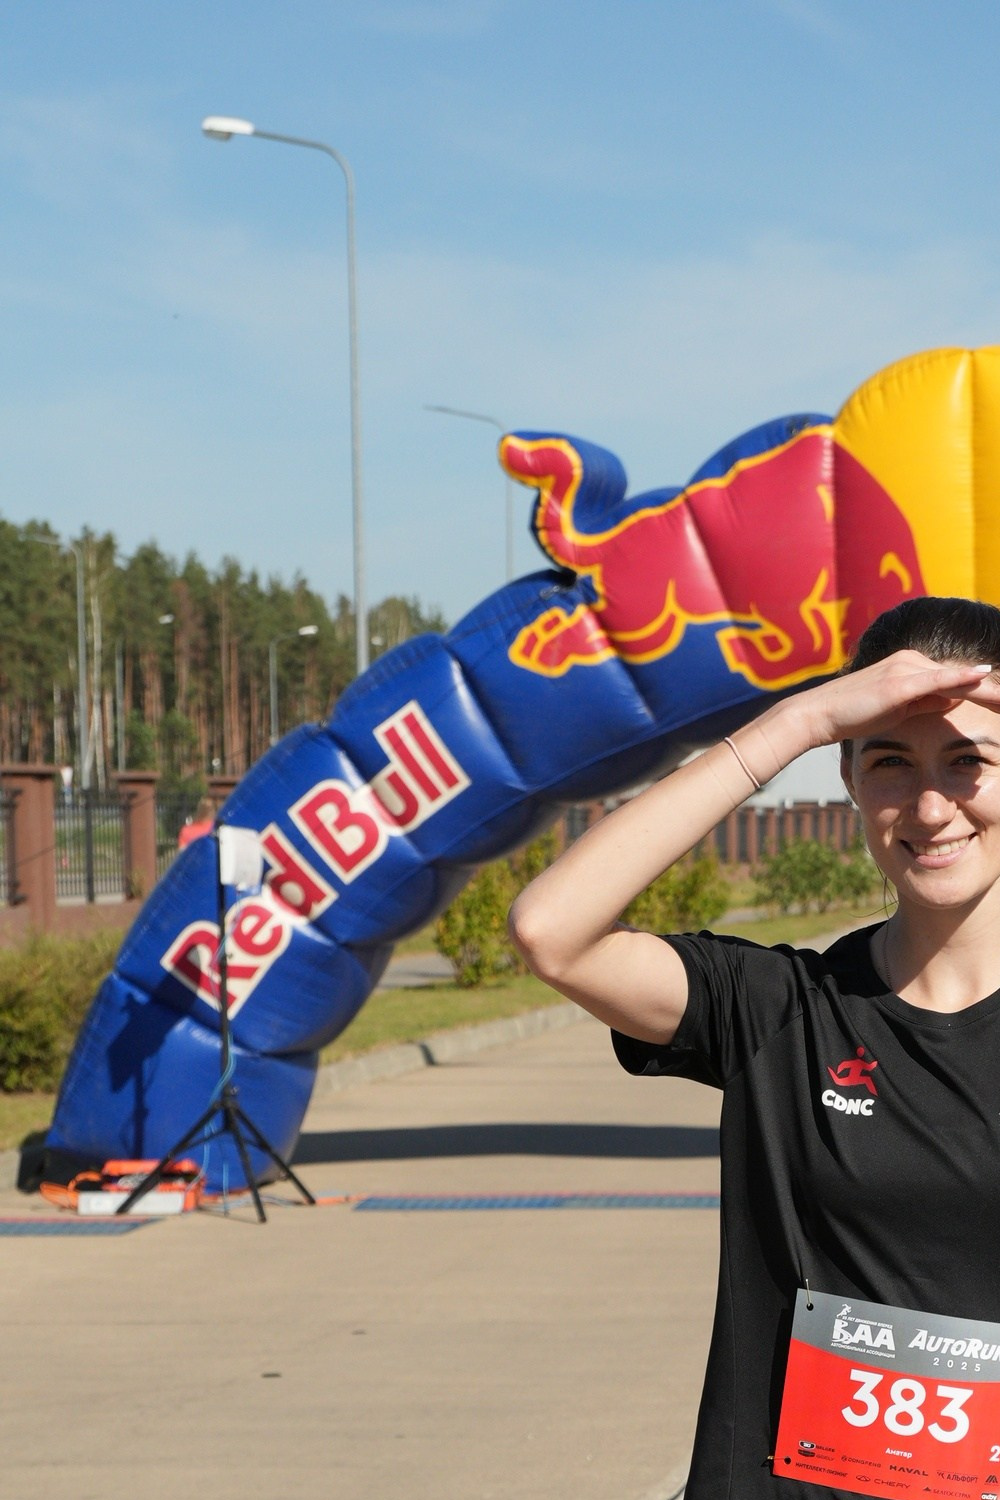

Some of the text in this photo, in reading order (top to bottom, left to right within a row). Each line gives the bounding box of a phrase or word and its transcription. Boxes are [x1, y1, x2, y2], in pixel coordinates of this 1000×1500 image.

[162, 702, 470, 1016] Red Bull
[821, 1089, 875, 1116] CDNC
[841, 1368, 974, 1444] 383
[873, 1478, 911, 1490] CHERY
[889, 1464, 929, 1477] HAVAL
